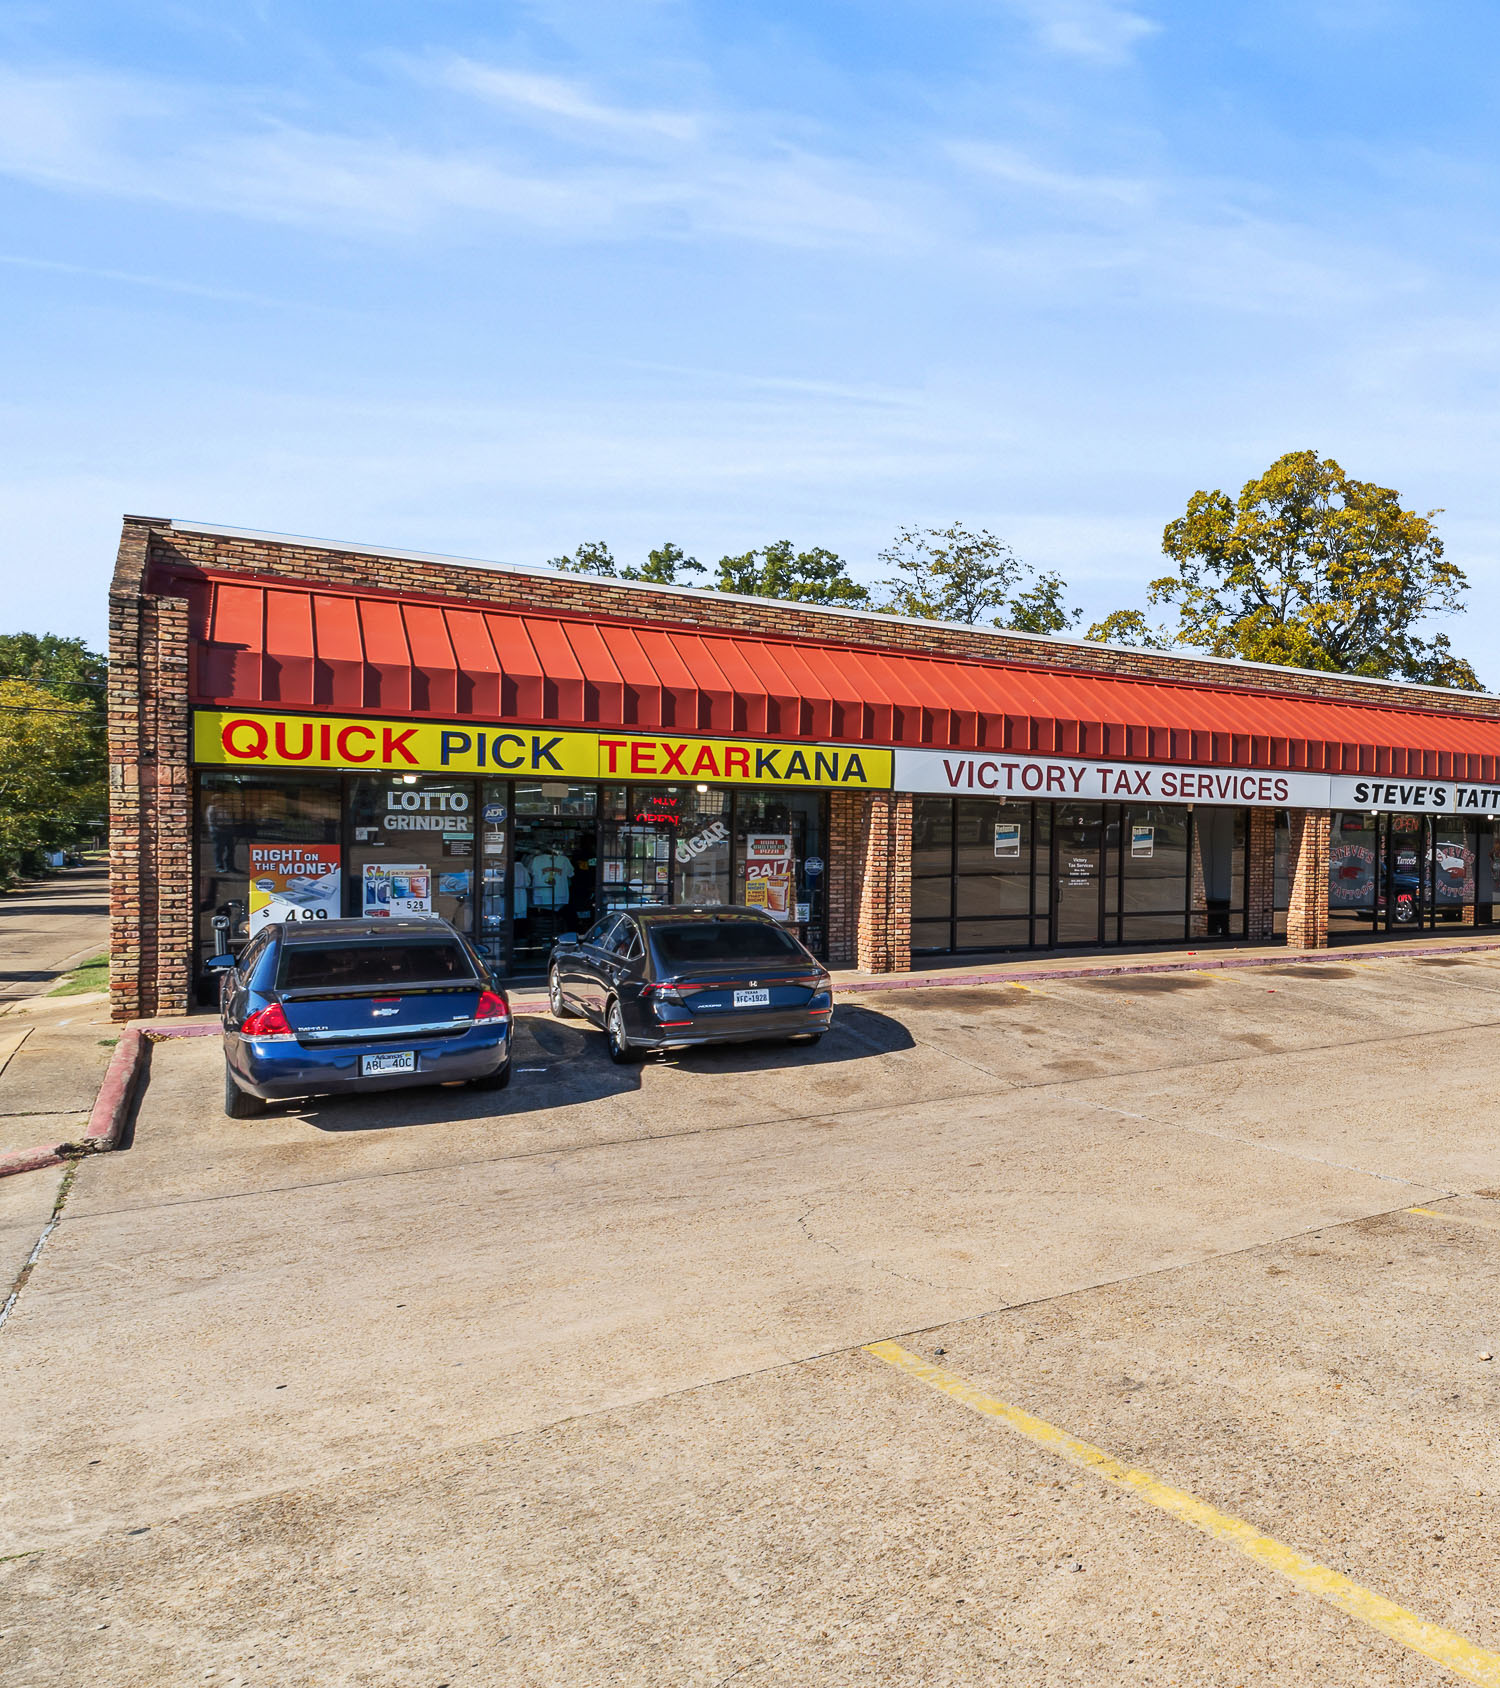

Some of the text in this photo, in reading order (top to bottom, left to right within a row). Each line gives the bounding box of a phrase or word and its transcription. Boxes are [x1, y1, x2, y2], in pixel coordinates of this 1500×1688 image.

[221, 719, 868, 783] QUICK PICK TEXARKANA
[943, 759, 1289, 801] VICTORY TAX SERVICES
[387, 791, 469, 811] LOTTO
[1354, 782, 1447, 807] STEVE'S
[383, 815, 468, 831] GRINDER
[485, 808, 504, 818] ADT
[1078, 817, 1085, 825] 2
[675, 821, 731, 863] CIGAR
[252, 849, 319, 862] RIGHT ON
[1330, 844, 1375, 864] STEVE'S
[255, 863, 338, 875] THE MONEY
[1330, 880, 1375, 900] TATTOOS
[365, 1059, 385, 1071] ABL
